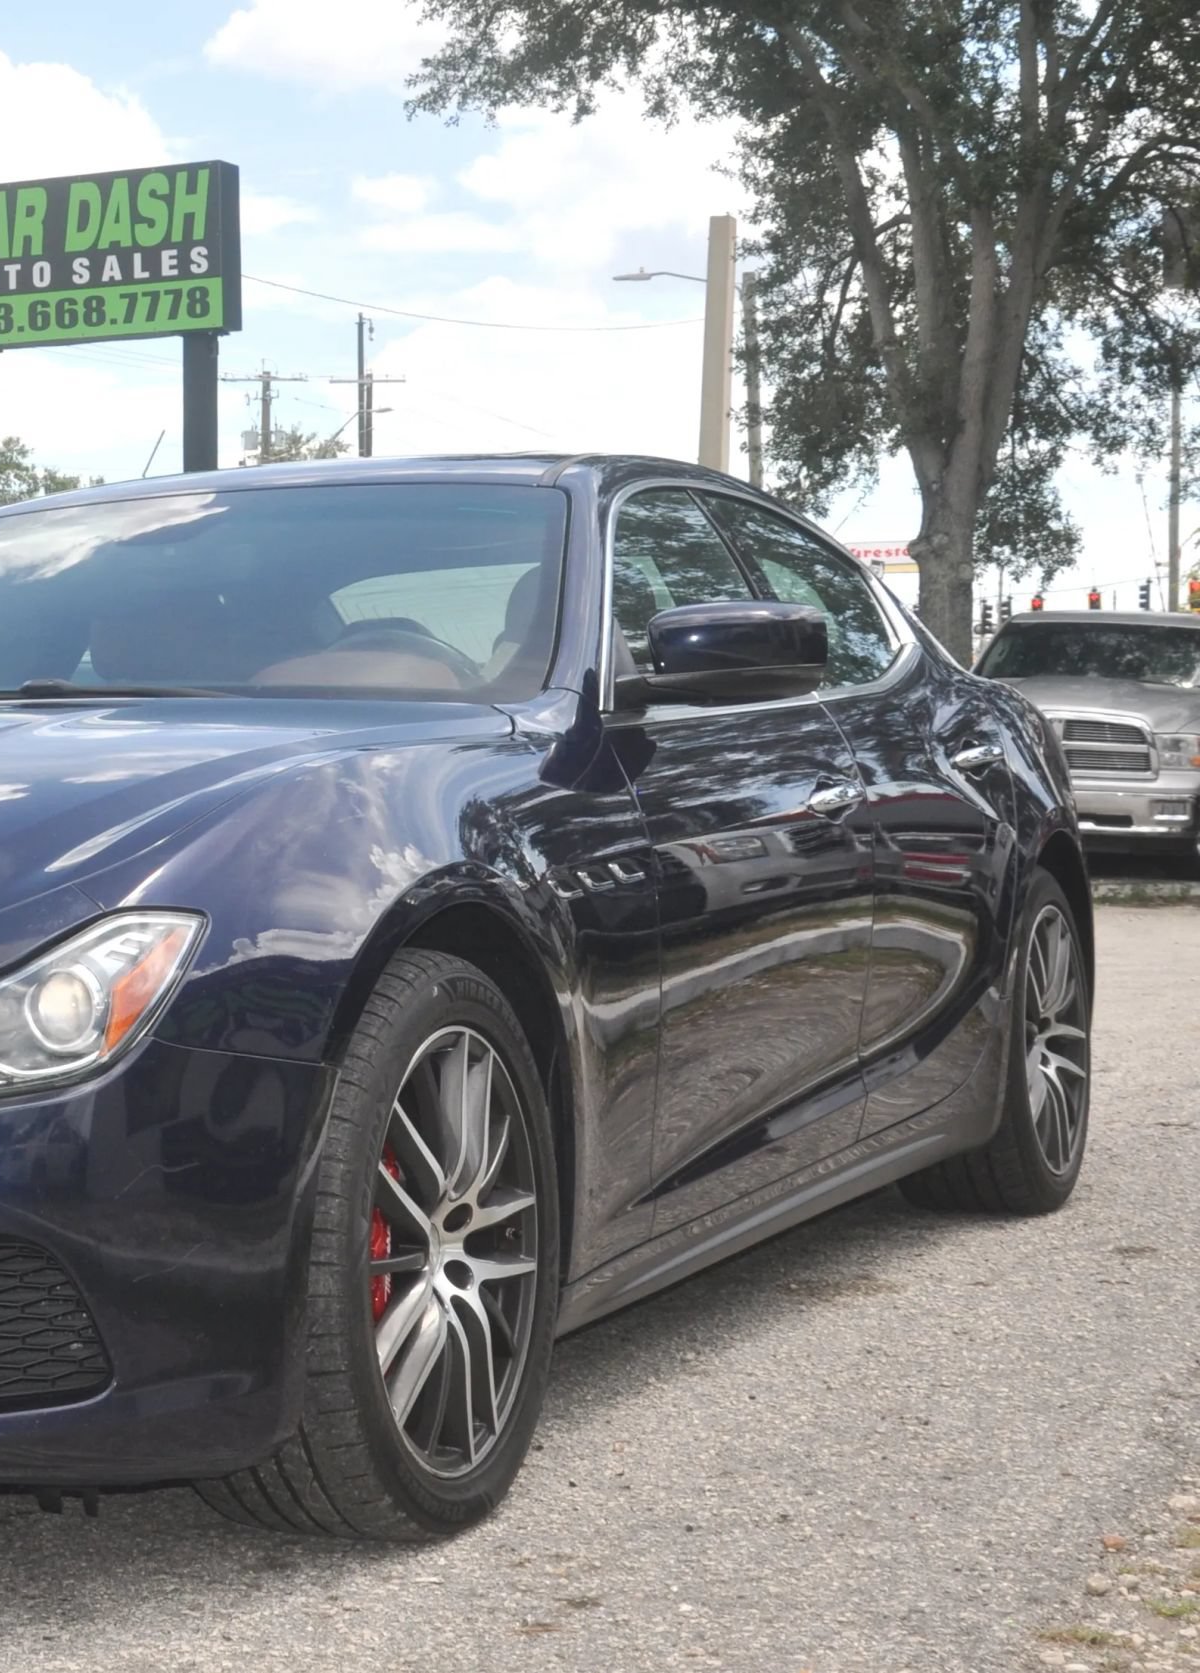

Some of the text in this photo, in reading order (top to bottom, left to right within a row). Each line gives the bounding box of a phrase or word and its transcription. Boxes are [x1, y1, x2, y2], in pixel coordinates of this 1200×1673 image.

[63, 167, 211, 253] DASH
[71, 246, 210, 285] SALES
[849, 548, 912, 558] iresto
